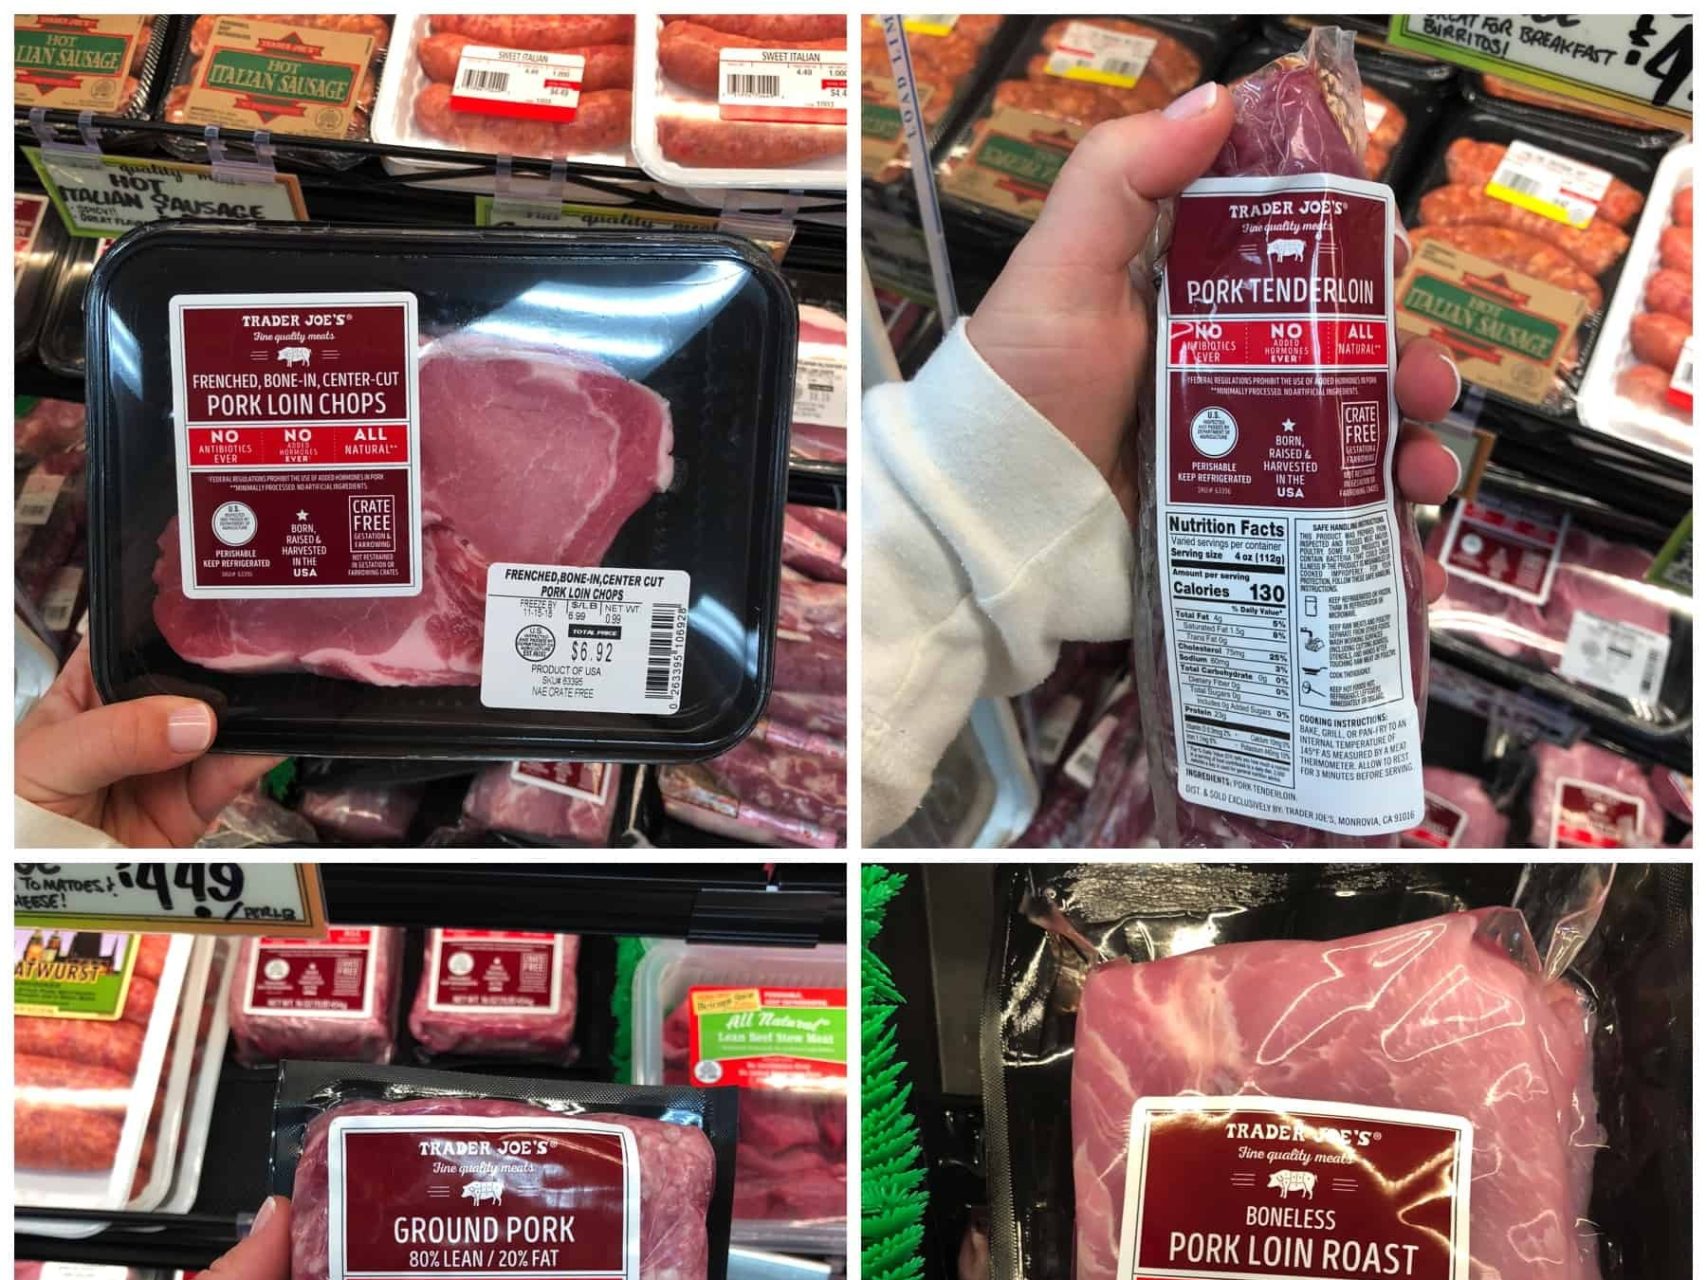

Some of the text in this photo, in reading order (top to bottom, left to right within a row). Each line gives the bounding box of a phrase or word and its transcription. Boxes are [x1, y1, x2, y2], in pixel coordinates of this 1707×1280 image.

[1423, 26, 1511, 59] BURRITOS!
[1483, 17, 1618, 66] FOR BREAKFAST
[57, 50, 120, 70] SAUSAGE
[762, 52, 820, 62] SWEET ITALIAN
[267, 61, 302, 74] HOT
[210, 66, 347, 100] ITALIAN SAUSAGE
[109, 174, 165, 194] HOT
[1230, 202, 1294, 218] TRADER
[1187, 278, 1374, 305] PORK TENDERLOIN
[243, 315, 300, 327] TRADER
[253, 332, 334, 343] Fine quality meats
[193, 371, 399, 391] FRENCHED, BONE-IN, CENTER-CUT
[208, 393, 386, 416] PORK LOIN CHOPS
[211, 430, 239, 443] NO
[284, 429, 312, 442] NO
[354, 428, 387, 440] ALL
[199, 444, 252, 454] ANTIBIOTICS
[214, 454, 237, 464] EVER
[1277, 488, 1304, 498] USA
[353, 500, 390, 513] CRATE
[353, 515, 390, 531] FREE
[1169, 516, 1284, 538] Nutrition Facts
[1171, 536, 1281, 551] Varied servings per container
[1171, 548, 1202, 560] Serving
[1205, 551, 1223, 560] size
[1255, 552, 1285, 565] (112g)
[1173, 568, 1250, 583] Amount per serving
[541, 587, 624, 600] PORK LOIN CHOPS
[1174, 581, 1285, 602] Calories 130
[571, 641, 612, 662] $6.92
[531, 665, 601, 676] PRODUCT OF USA
[1300, 714, 1333, 724] COOKING
[1226, 1123, 1305, 1143] TRADER
[419, 1141, 490, 1156] TRADER
[433, 1161, 456, 1174] Fine
[460, 1162, 498, 1177] quality
[1246, 1206, 1336, 1231] BONELESS
[394, 1215, 575, 1244] GROUND PORK
[409, 1250, 440, 1268] 80%
[443, 1249, 484, 1268] LEAN
[499, 1249, 529, 1268] 20%
[532, 1249, 559, 1267] FAT
[1169, 1232, 1420, 1276] PORK LOIN ROAST
